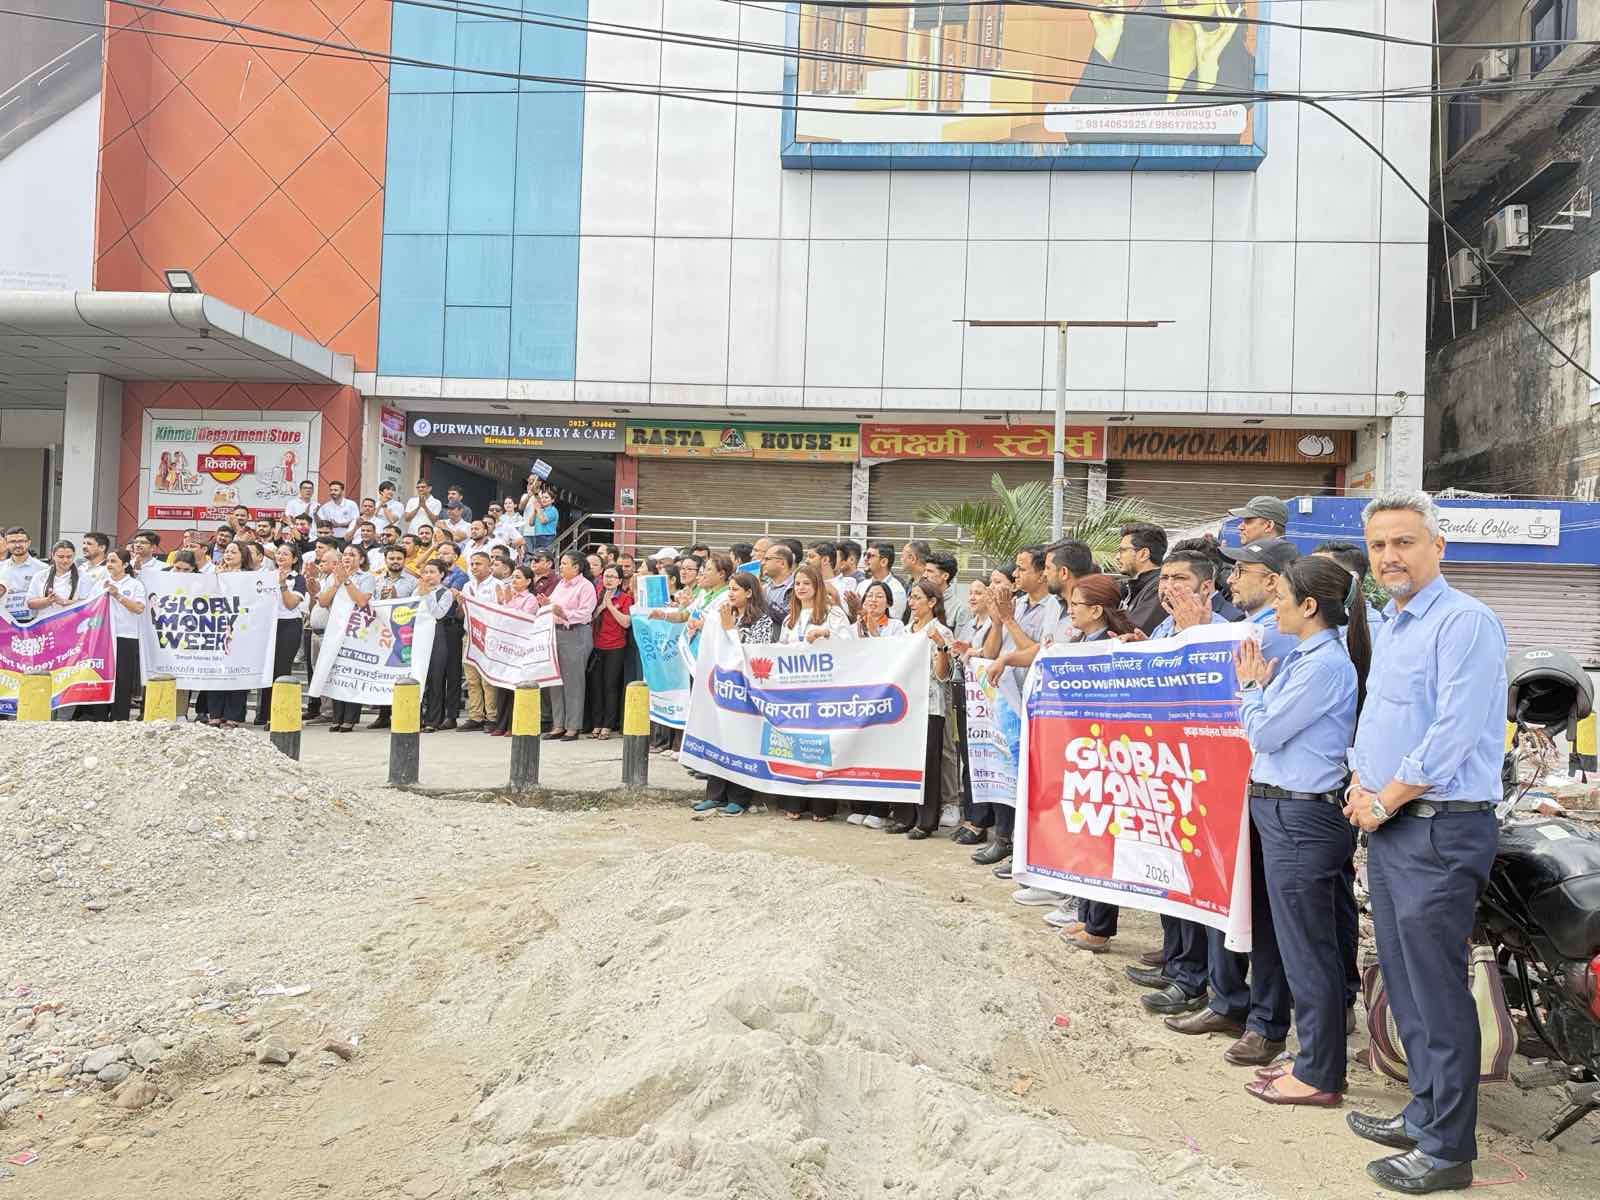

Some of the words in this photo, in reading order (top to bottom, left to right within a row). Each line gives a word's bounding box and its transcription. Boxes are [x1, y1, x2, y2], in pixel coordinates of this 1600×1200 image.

[155, 427, 197, 441] Kinmel
[197, 427, 268, 442] Department
[270, 428, 302, 443] Store
[432, 423, 515, 437] PURWANCHAL
[519, 426, 569, 438] BAKERY
[572, 429, 580, 438] &
[584, 429, 616, 440] CAFE
[631, 428, 705, 447] RASTA
[760, 432, 832, 450] HOUSE
[869, 429, 970, 456] लक्ष्मी
[1120, 430, 1269, 457] MOMOLAYA
[204, 456, 248, 470] किनमेल
[1481, 518, 1520, 538] Coffee
[158, 595, 249, 615] GLOBAL
[156, 614, 239, 633] MONEY
[157, 631, 227, 651] WEEK
[777, 654, 834, 674] NIMB
[1157, 672, 1223, 688] LIMITED
[816, 694, 894, 718] कार्यक्रम
[1065, 736, 1207, 781] GLOBAL
[1063, 769, 1192, 816] MONEY
[1061, 799, 1183, 853] WEEK
[1145, 864, 1170, 884] 2026
